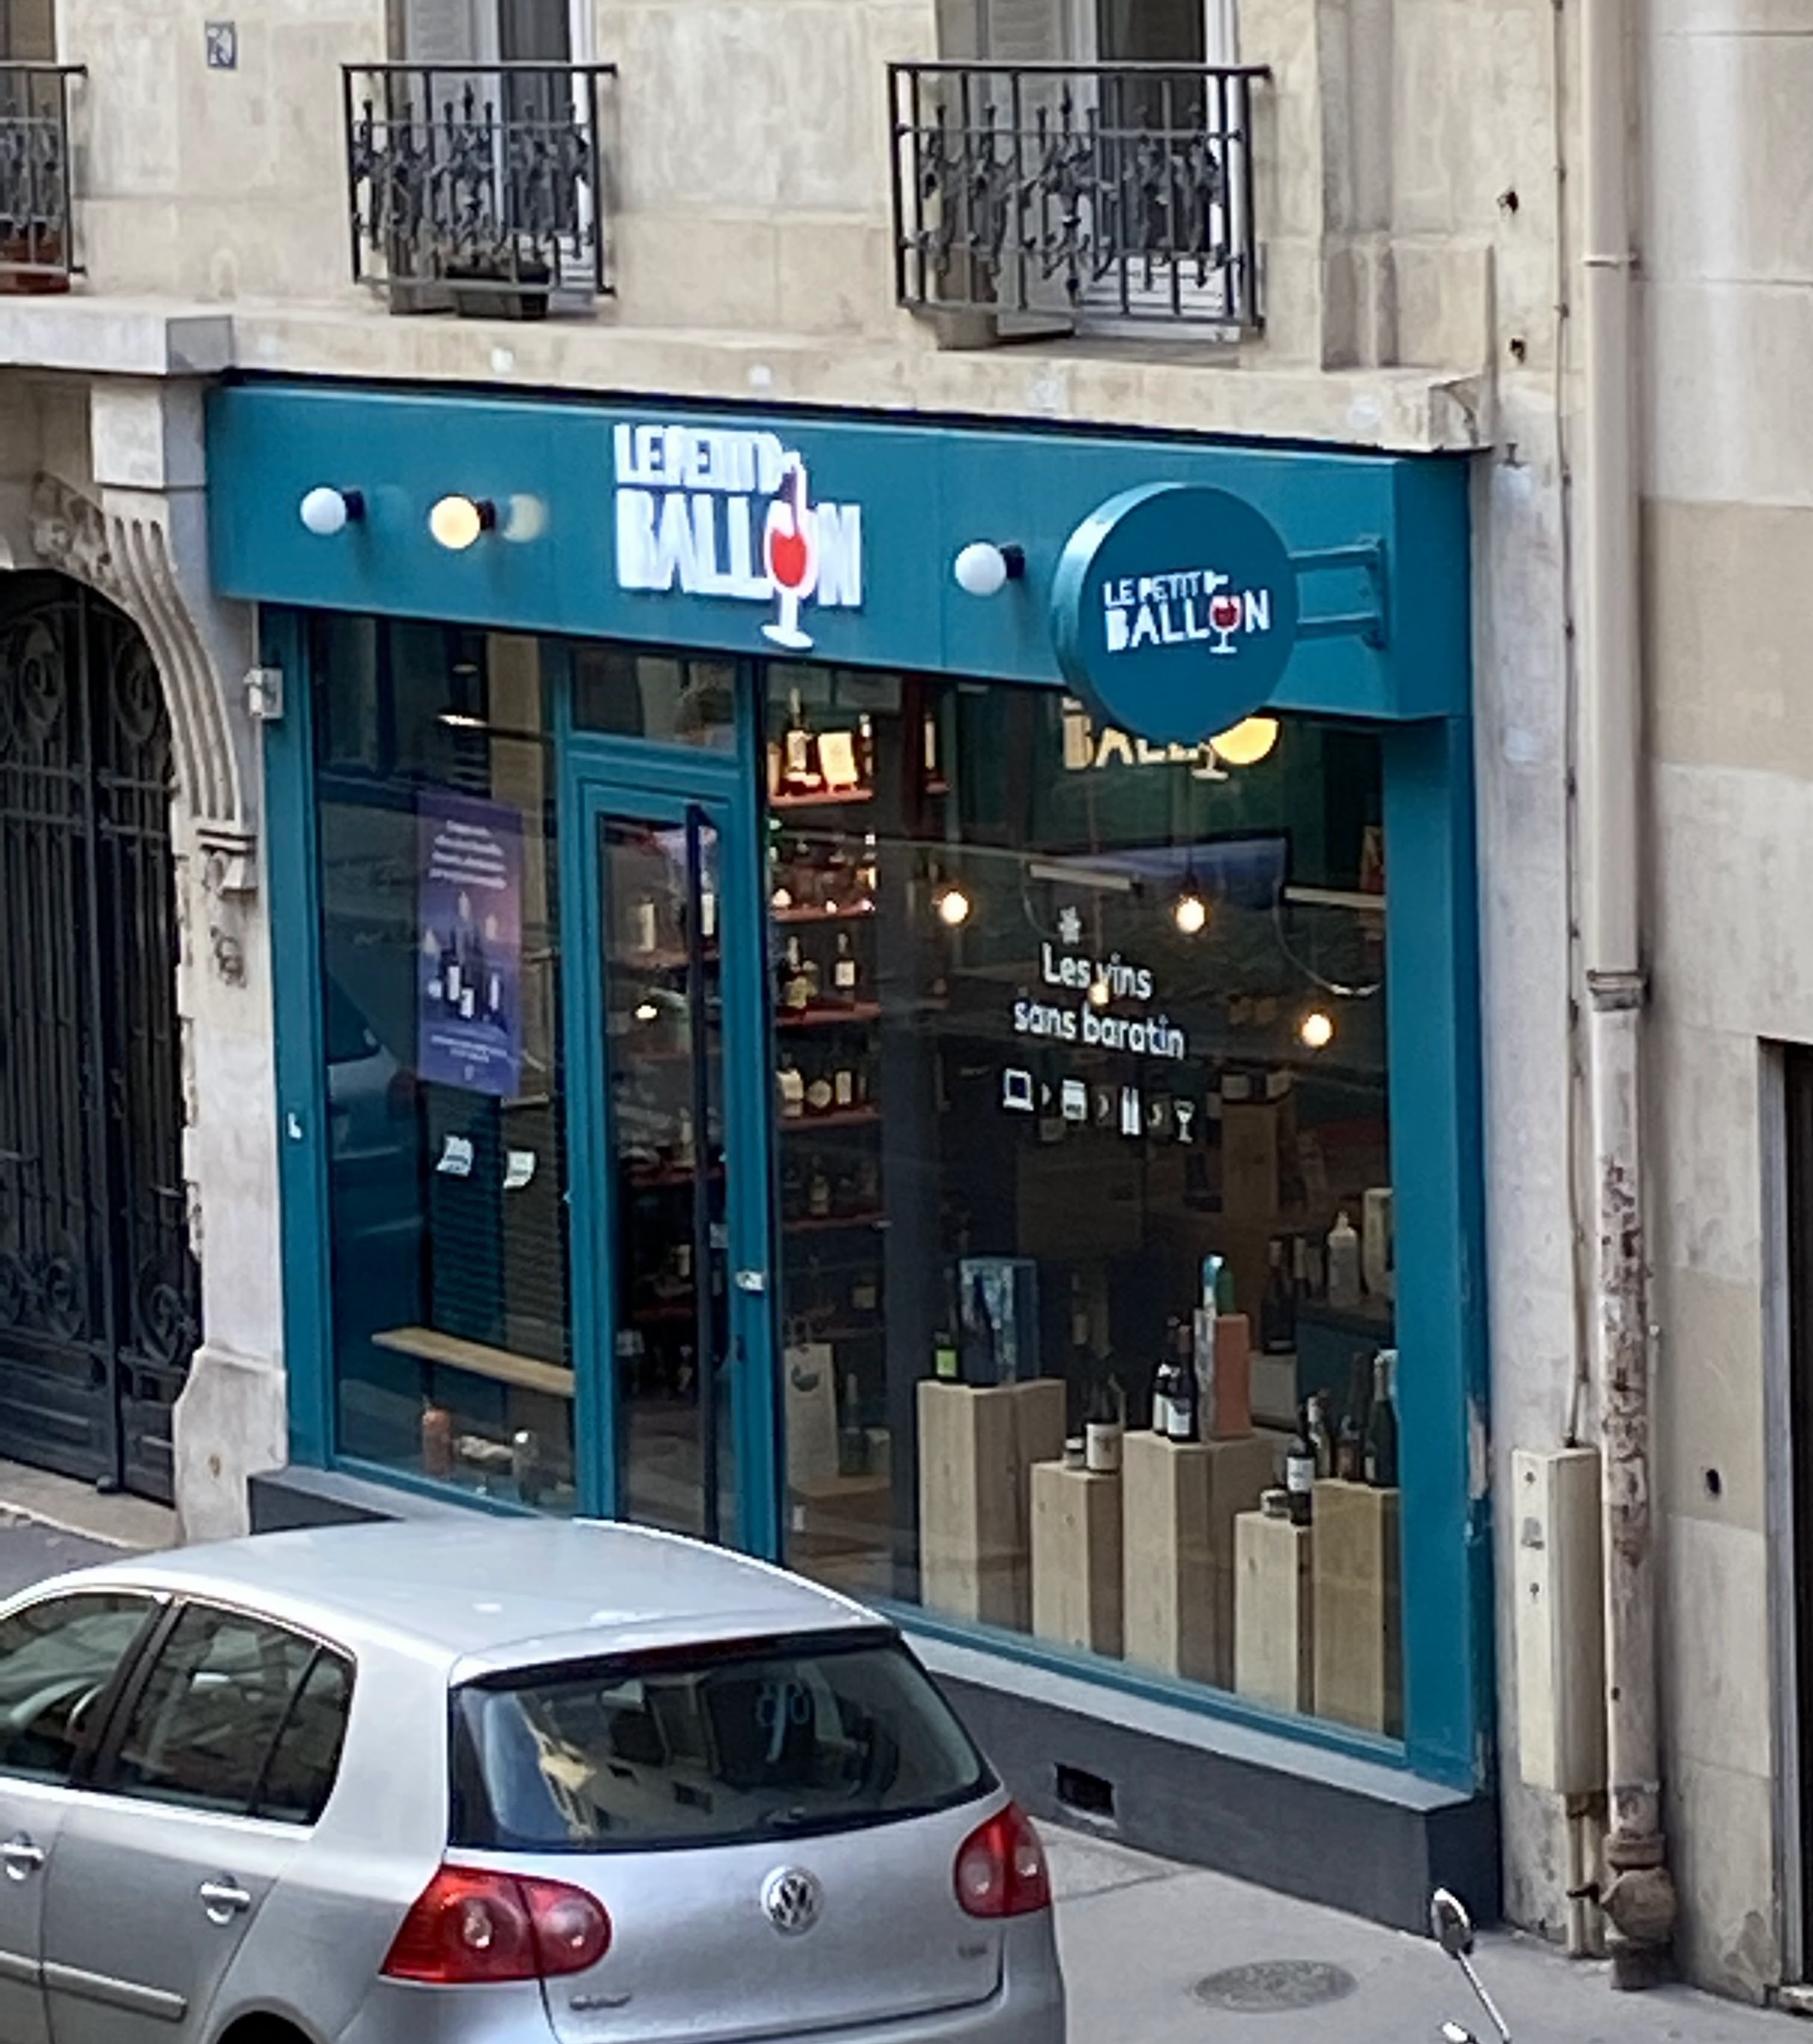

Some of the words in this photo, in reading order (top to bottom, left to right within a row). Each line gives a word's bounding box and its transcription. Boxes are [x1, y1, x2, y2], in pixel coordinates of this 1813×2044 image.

[614, 424, 664, 484] LE
[664, 425, 756, 492] PETIT
[616, 489, 861, 605] BALLON
[1104, 579, 1135, 607] LE
[1138, 571, 1201, 602] PETIT
[1106, 589, 1270, 653] BALLON
[1042, 942, 1091, 989] Les
[1095, 952, 1152, 1000] vins
[1014, 1002, 1077, 1039] sans
[1082, 1002, 1185, 1060] baratin
